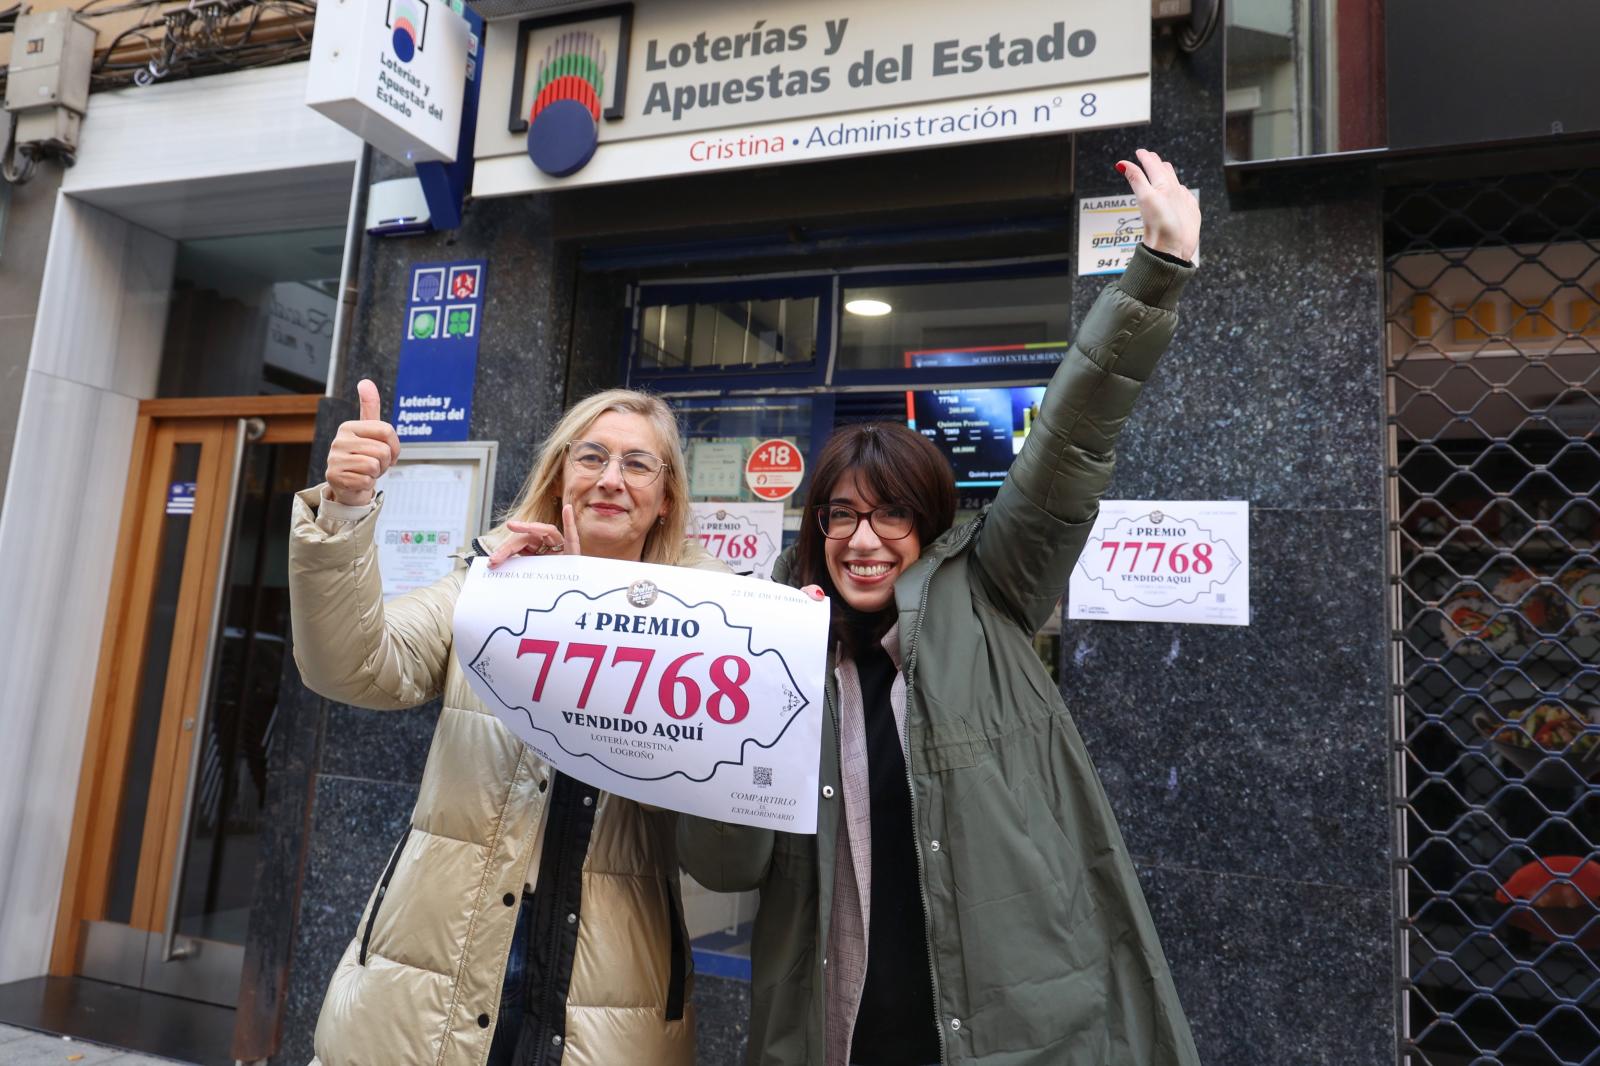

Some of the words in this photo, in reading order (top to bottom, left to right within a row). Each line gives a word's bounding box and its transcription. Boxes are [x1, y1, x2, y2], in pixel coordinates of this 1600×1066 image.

[646, 19, 808, 72] Loterías
[824, 18, 849, 56] y
[642, 64, 831, 121] Apuestas
[848, 43, 914, 88] del
[932, 21, 1097, 77] Estado
[379, 70, 425, 110] Apuestas
[428, 103, 443, 121] del
[424, 84, 430, 97] y
[376, 86, 412, 118] Estado
[690, 134, 785, 161] Cristina
[806, 104, 1017, 149] Administración
[1080, 93, 1097, 117] 8
[1082, 199, 1127, 210] ALARMA
[1092, 235, 1130, 248] grupo
[1097, 257, 1120, 268] 941
[399, 394, 442, 408] Loterías
[443, 397, 451, 409] y
[398, 410, 447, 424] Apuestas
[447, 407, 465, 420] del
[396, 423, 433, 436] Estado
[759, 445, 791, 466] +18
[1137, 527, 1186, 537] PREMIO
[1101, 541, 1213, 574] 77768
[1121, 574, 1164, 583] VENDIDO
[595, 612, 700, 638] PREMIO
[516, 638, 751, 725] 77768
[561, 710, 648, 735] VENDIDO
[652, 722, 704, 742] AQUÍ
[610, 746, 655, 760] LOGROÑO
[631, 740, 674, 752] CRISTINA
[730, 791, 797, 807] COMPARTIRLO
[731, 807, 795, 821] EXTRAORDINARIO
